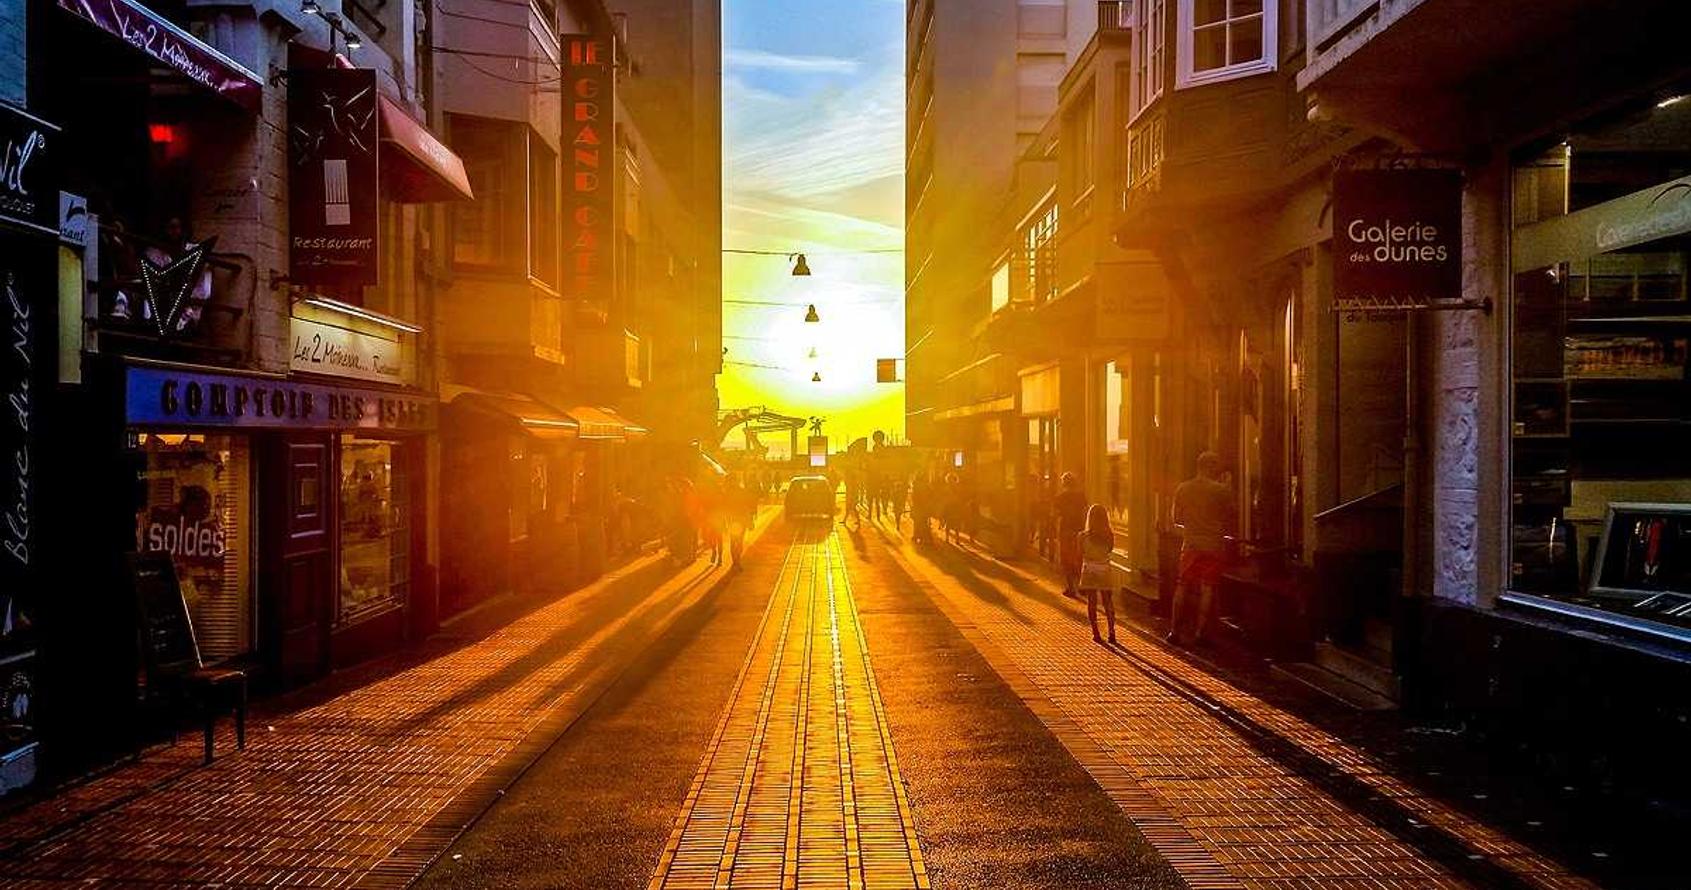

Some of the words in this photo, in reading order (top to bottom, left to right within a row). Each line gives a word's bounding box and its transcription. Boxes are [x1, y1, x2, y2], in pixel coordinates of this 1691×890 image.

[145, 24, 160, 58] 2
[573, 77, 600, 193] GRAND
[293, 236, 372, 250] Restaurant
[1347, 219, 1438, 244] Galerie
[1349, 250, 1371, 262] des
[1373, 243, 1448, 262] dunes
[310, 332, 322, 364] 2
[325, 393, 365, 421] DES
[4, 442, 29, 566] Blanc
[148, 514, 226, 558] soldes
